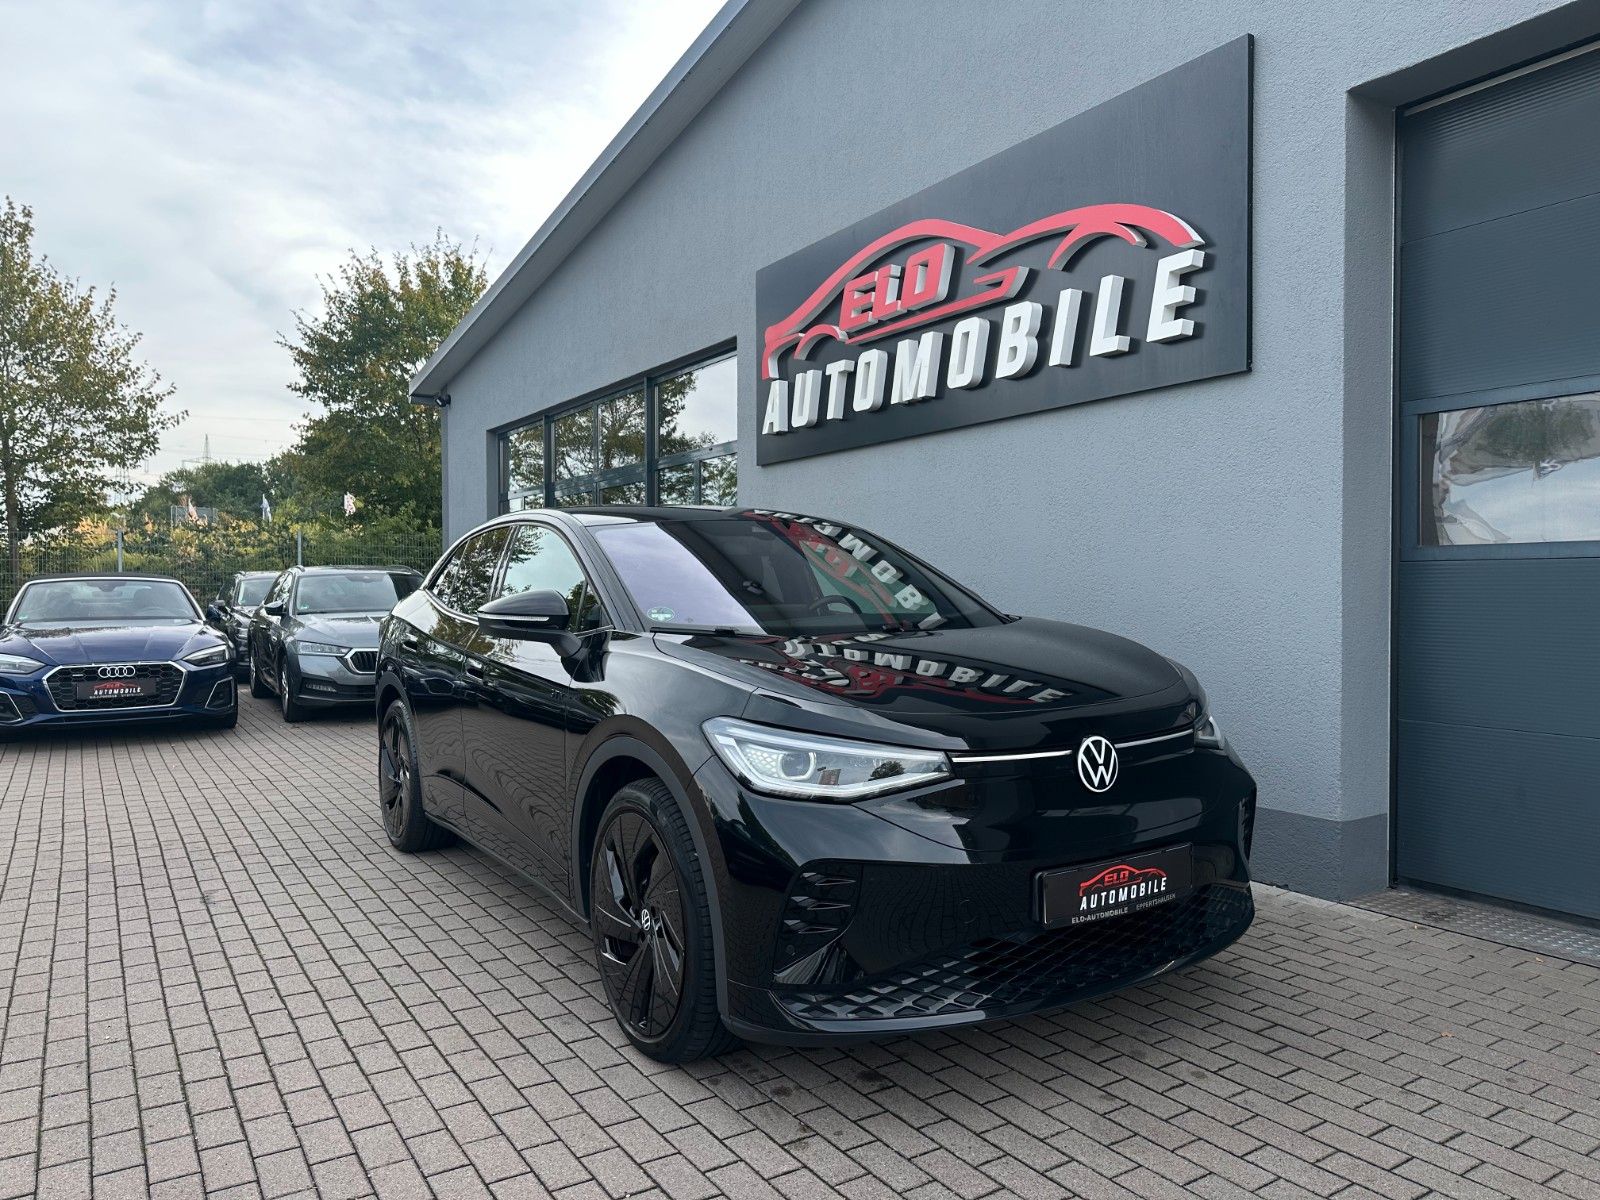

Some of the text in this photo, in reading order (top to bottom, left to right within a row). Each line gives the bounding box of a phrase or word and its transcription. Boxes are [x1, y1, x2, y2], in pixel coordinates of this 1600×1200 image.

[838, 243, 955, 332] ELO
[762, 248, 1205, 435] AUTOMOBILE
[94, 687, 141, 695] AUTOMOBILE
[1104, 871, 1129, 886] ELO
[1080, 877, 1167, 911] AUTOMOBILE
[1071, 906, 1129, 924] ELO-AUTOMOBILE
